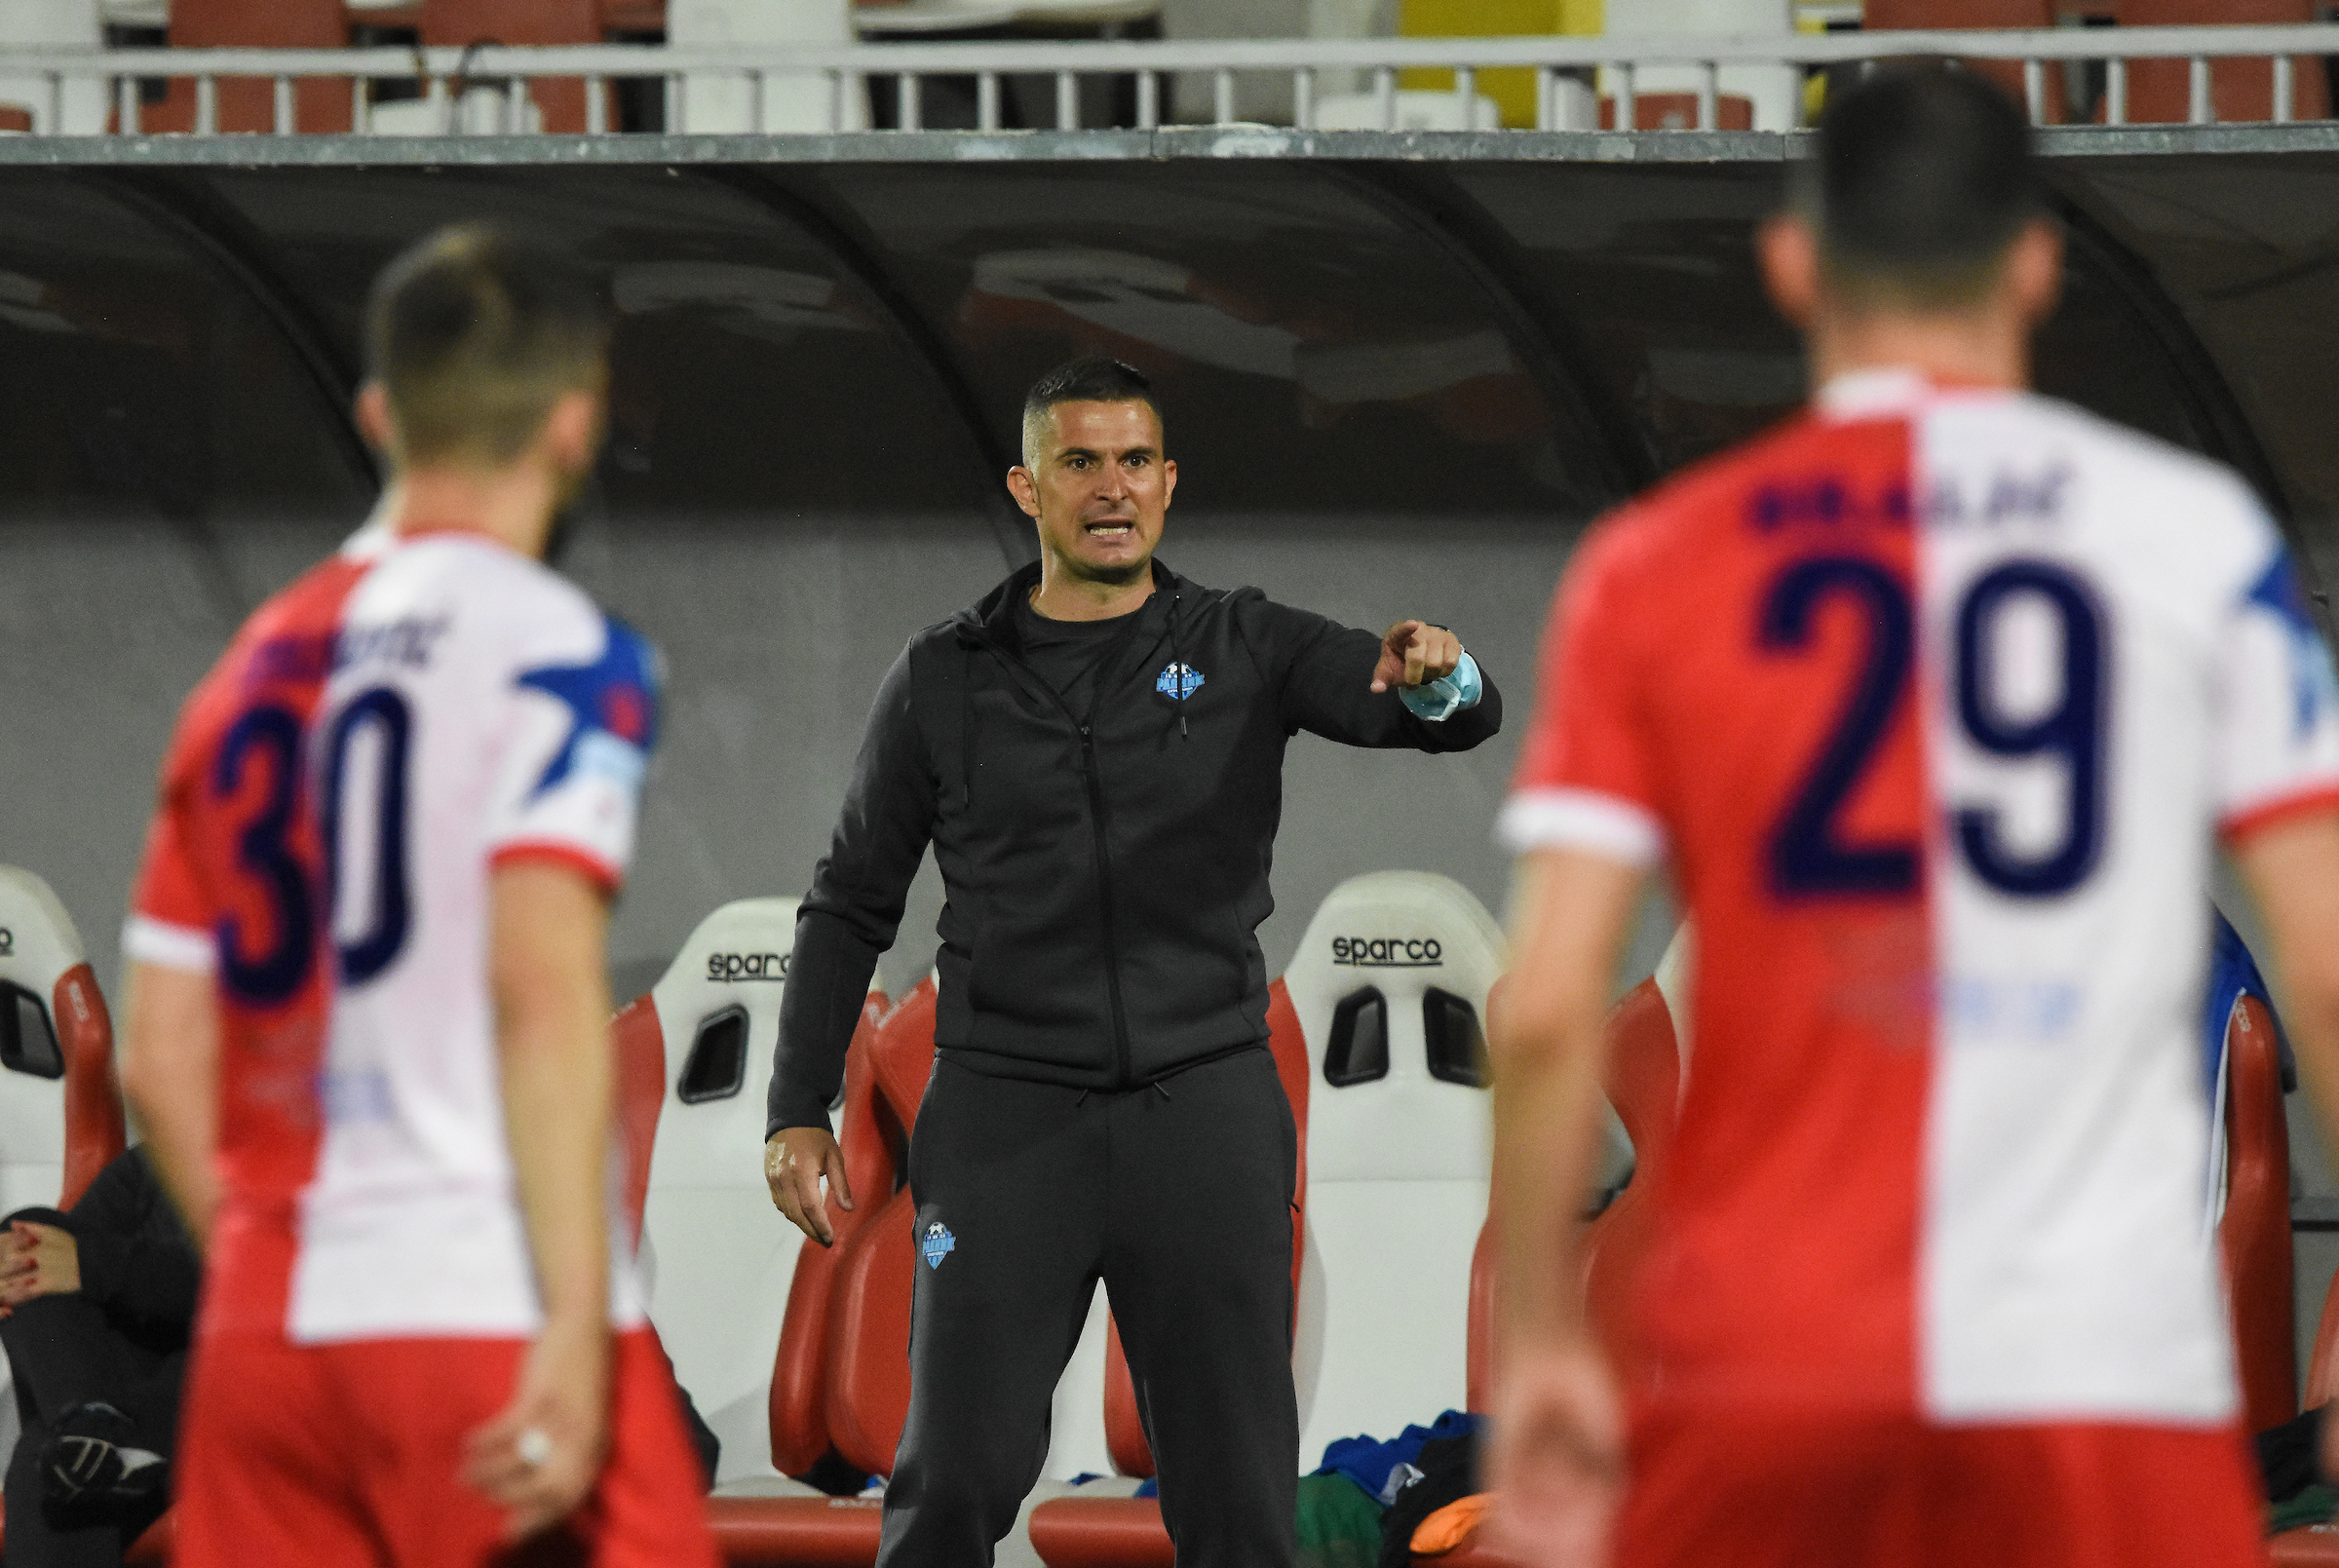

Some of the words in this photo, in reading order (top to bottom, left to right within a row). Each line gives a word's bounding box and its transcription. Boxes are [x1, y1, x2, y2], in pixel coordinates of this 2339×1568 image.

[211, 684, 416, 1006] 30
[1757, 555, 2113, 902] 29
[1332, 937, 1441, 966] sparco
